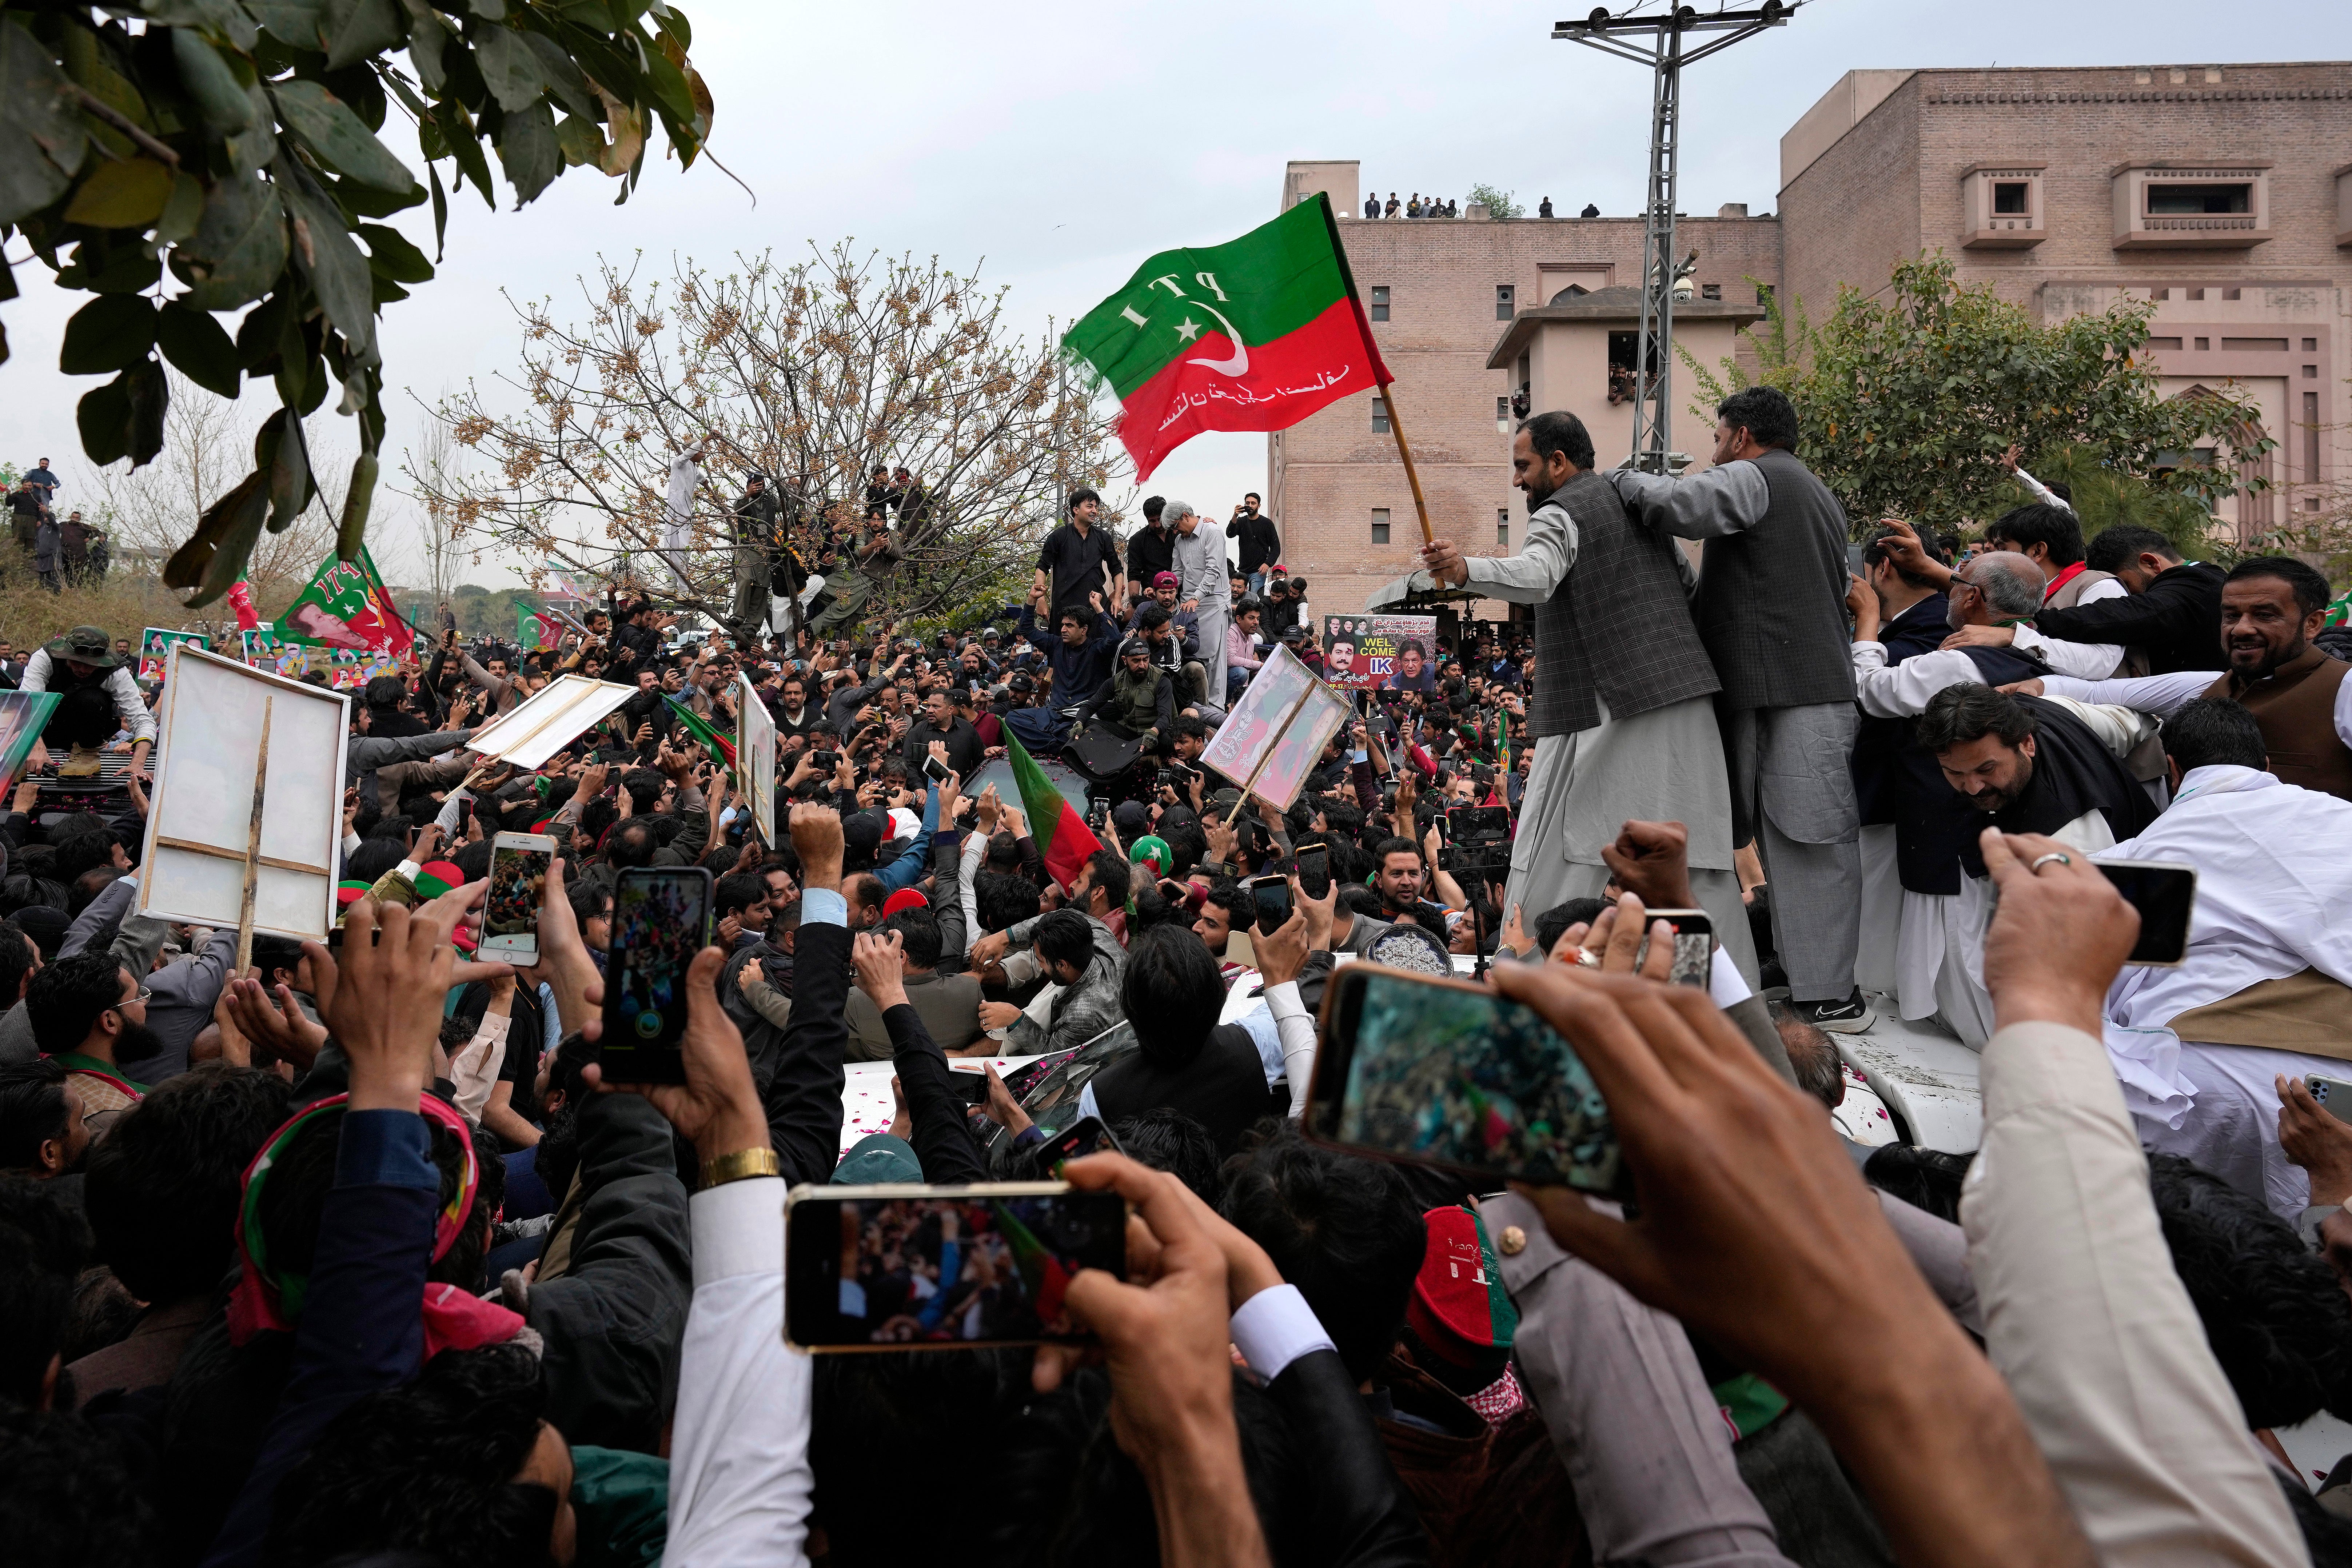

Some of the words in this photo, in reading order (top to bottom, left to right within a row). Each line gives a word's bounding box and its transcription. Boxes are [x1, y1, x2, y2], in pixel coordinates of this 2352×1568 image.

[1364, 638, 1392, 646] WEL
[1360, 647, 1396, 656] COME
[1371, 658, 1392, 674] IK
